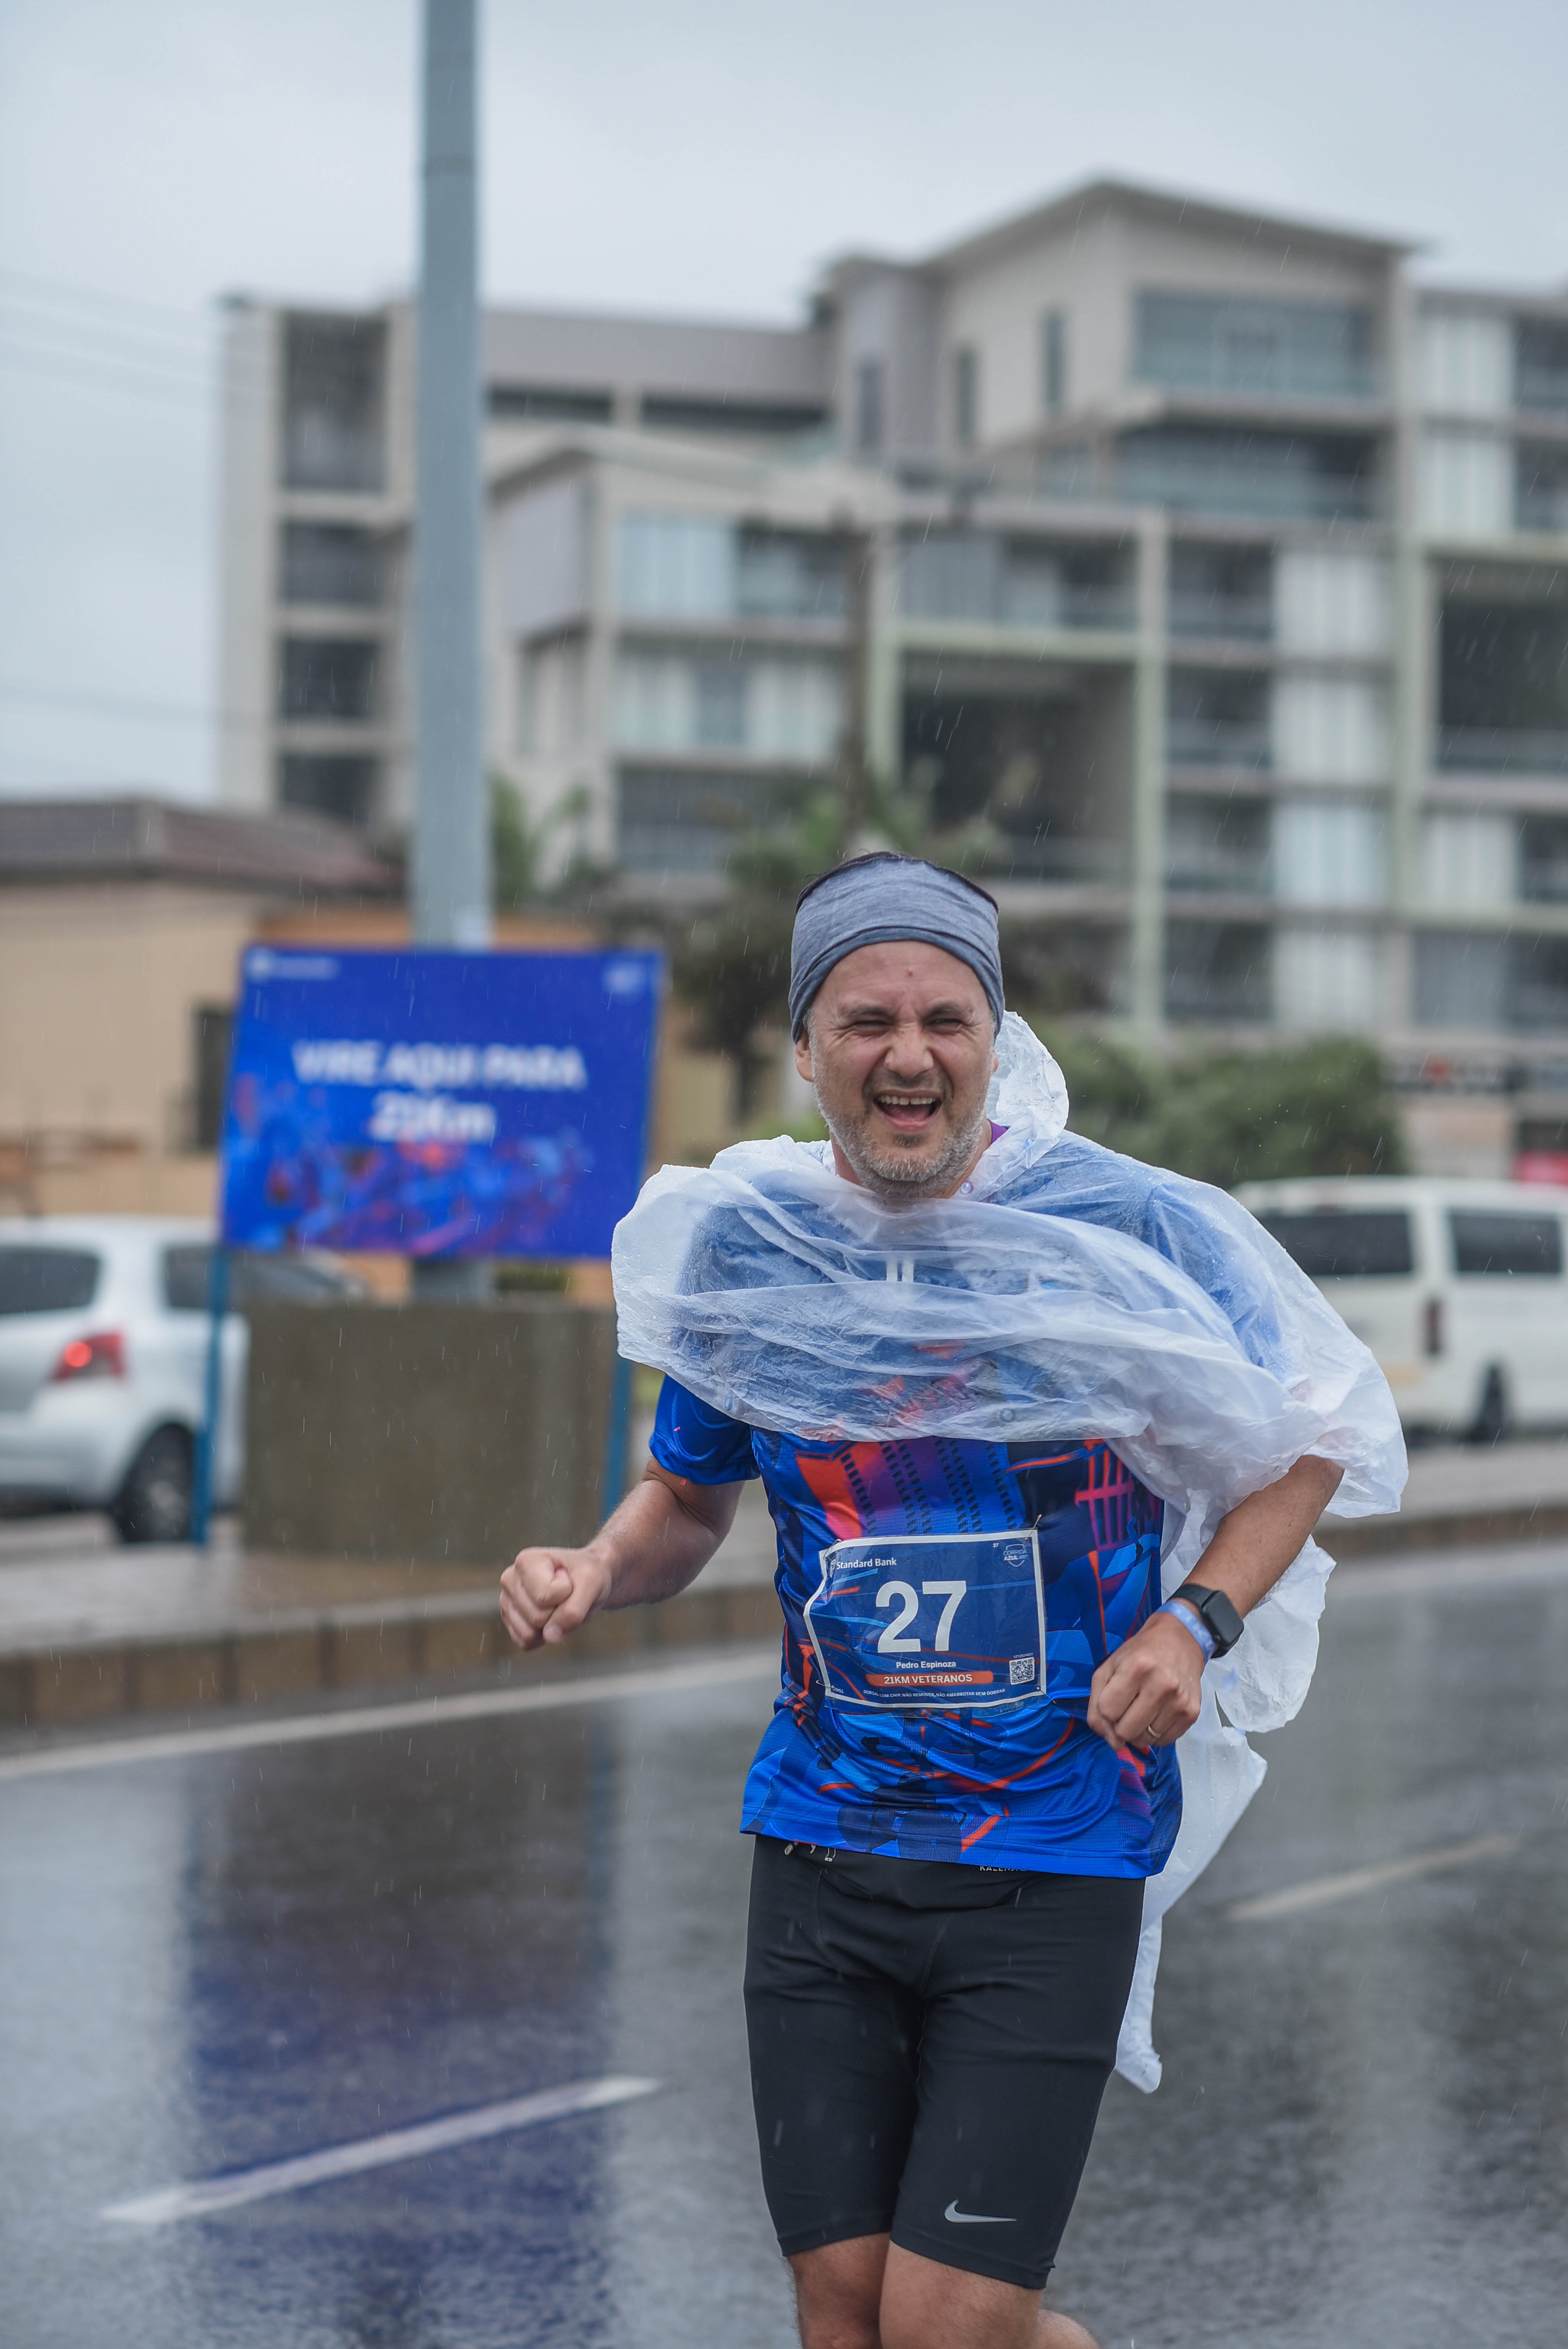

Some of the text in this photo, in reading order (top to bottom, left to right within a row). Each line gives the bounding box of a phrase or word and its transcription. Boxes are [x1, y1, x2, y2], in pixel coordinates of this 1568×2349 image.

[836, 1557, 897, 1570] Standard Bank
[876, 1581, 967, 1653] 27
[921, 1661, 956, 1670] Espinoza
[912, 1674, 973, 1684] VETERANOS
